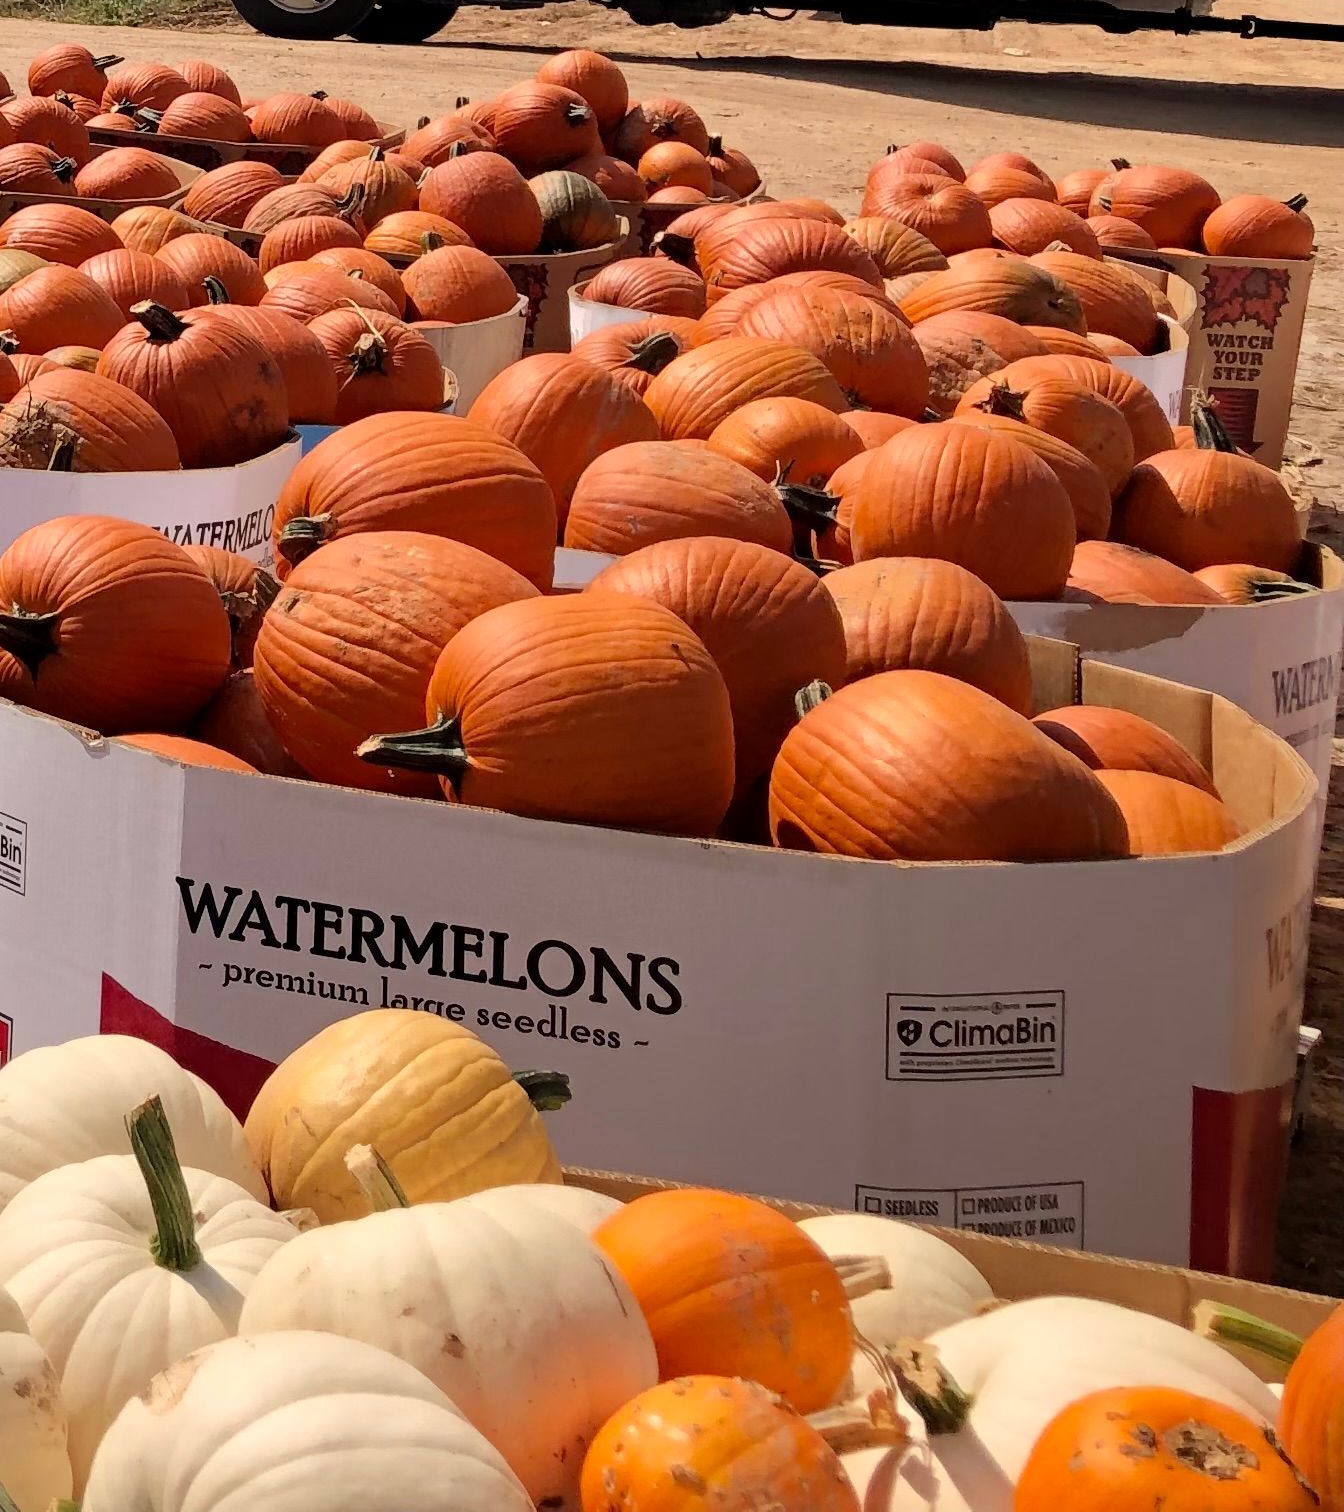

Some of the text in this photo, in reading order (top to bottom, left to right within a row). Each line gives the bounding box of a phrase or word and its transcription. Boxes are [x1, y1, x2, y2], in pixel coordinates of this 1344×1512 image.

[1207, 334, 1274, 350] WATCH
[1213, 350, 1263, 366] YOUR
[1213, 366, 1261, 381] STEP
[175, 876, 683, 1016] WATERMELONS
[223, 961, 369, 1007] premium
[476, 1003, 621, 1050] seedless
[929, 1017, 1055, 1048] ClimaBin
[885, 1199, 939, 1216] SEEDLESS
[977, 1194, 1060, 1214] PRODUCE OF USA
[977, 1217, 1075, 1237] PRODUCE OF MEXICO
